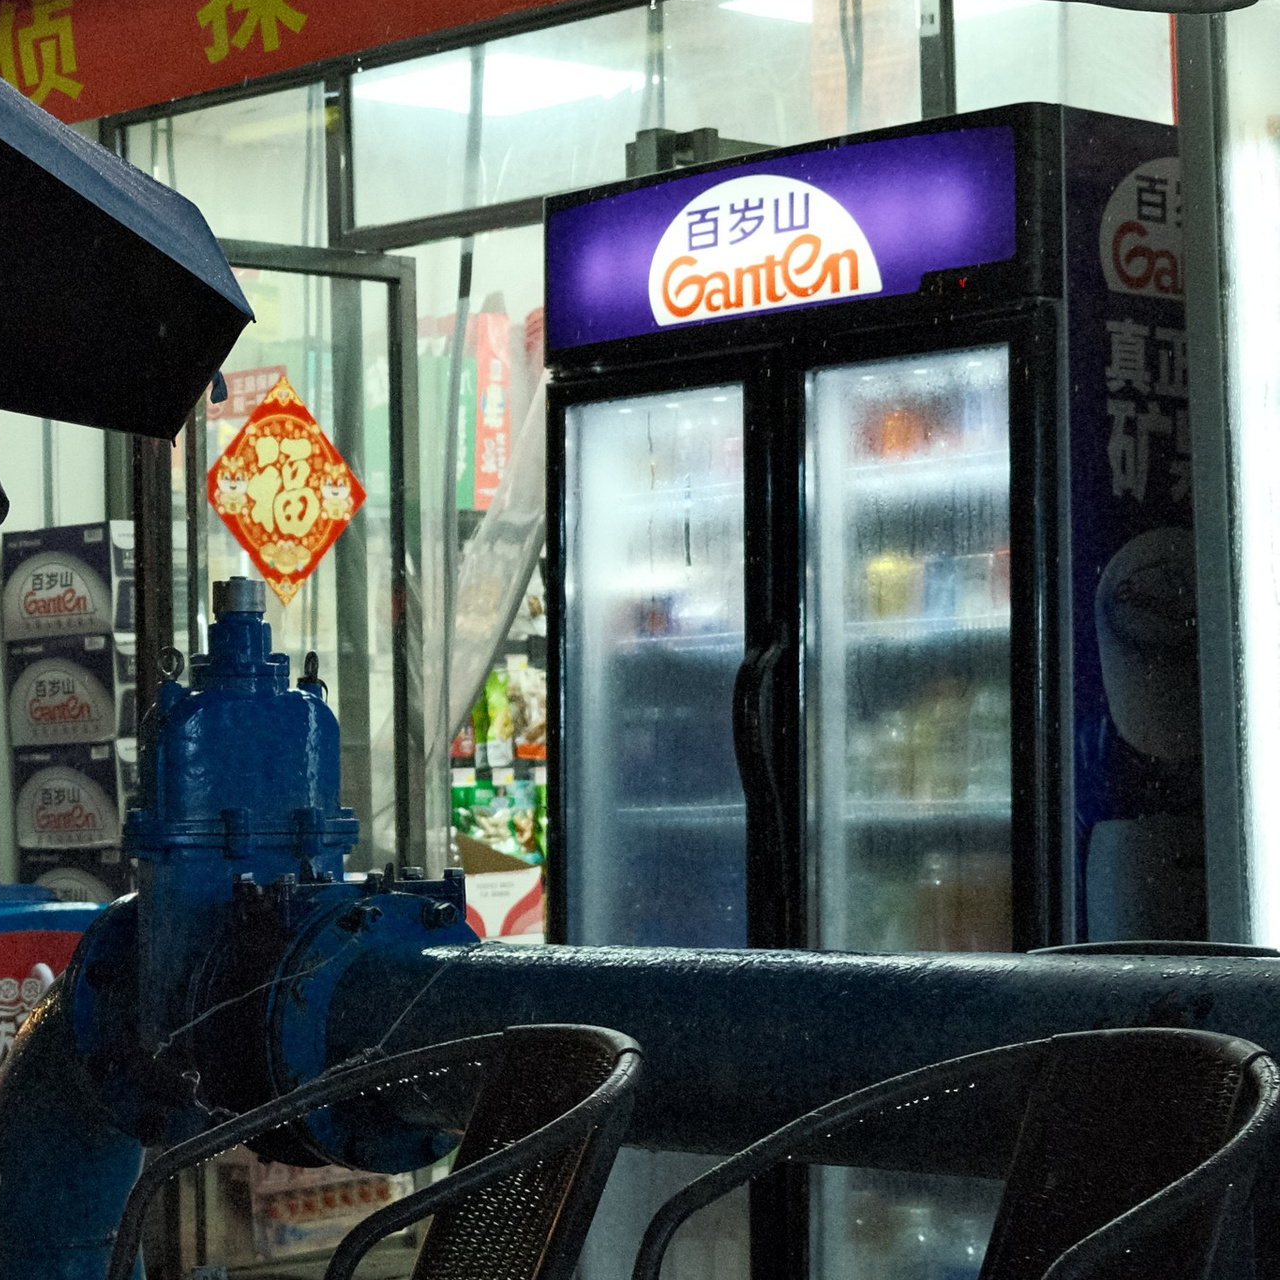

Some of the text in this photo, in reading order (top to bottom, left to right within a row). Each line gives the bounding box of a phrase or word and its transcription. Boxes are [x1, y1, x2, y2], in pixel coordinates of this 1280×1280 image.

[1135, 173, 1183, 230] 百
[687, 191, 811, 252] 百岁山
[246, 435, 321, 538] 福
[31, 571, 74, 591] 百岁山
[36, 677, 75, 698] 百岁山
[40, 786, 81, 806] 百岁山
